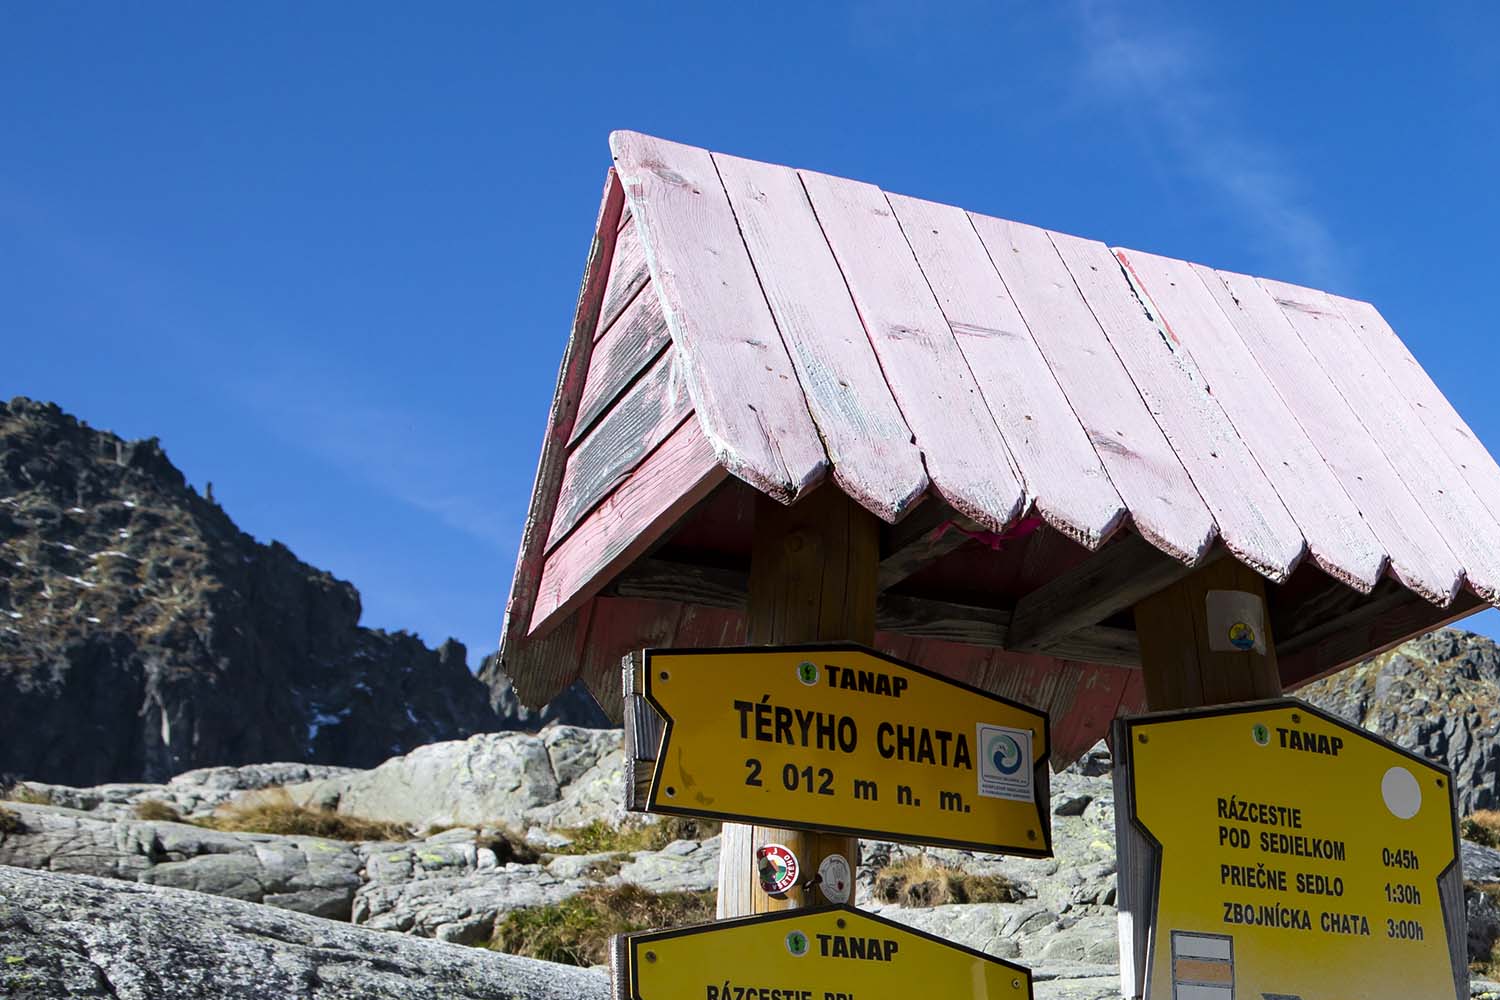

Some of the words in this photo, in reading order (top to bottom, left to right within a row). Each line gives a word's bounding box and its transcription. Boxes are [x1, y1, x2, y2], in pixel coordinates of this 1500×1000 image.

[825, 665, 907, 698] TANAP
[734, 694, 857, 753] TÉRYHO
[877, 722, 972, 769] CHATA
[1276, 728, 1343, 756] TANAP
[854, 779, 877, 801] m
[897, 785, 920, 806] n.
[940, 791, 970, 813] m.
[1218, 795, 1302, 828] RÁZCESTIE
[1219, 826, 1250, 848] POD
[1260, 832, 1345, 861] SEDIELKOM
[1382, 848, 1419, 870] 0:45h
[1221, 863, 1287, 891] PRIEČNE
[1297, 873, 1343, 896] SEDLO
[1385, 883, 1420, 904] 1:30h
[1224, 902, 1312, 930] ZBOJNÍCKA
[1321, 912, 1370, 935] CHATA
[1387, 919, 1423, 940] 3:00h
[816, 934, 898, 961] TANAP
